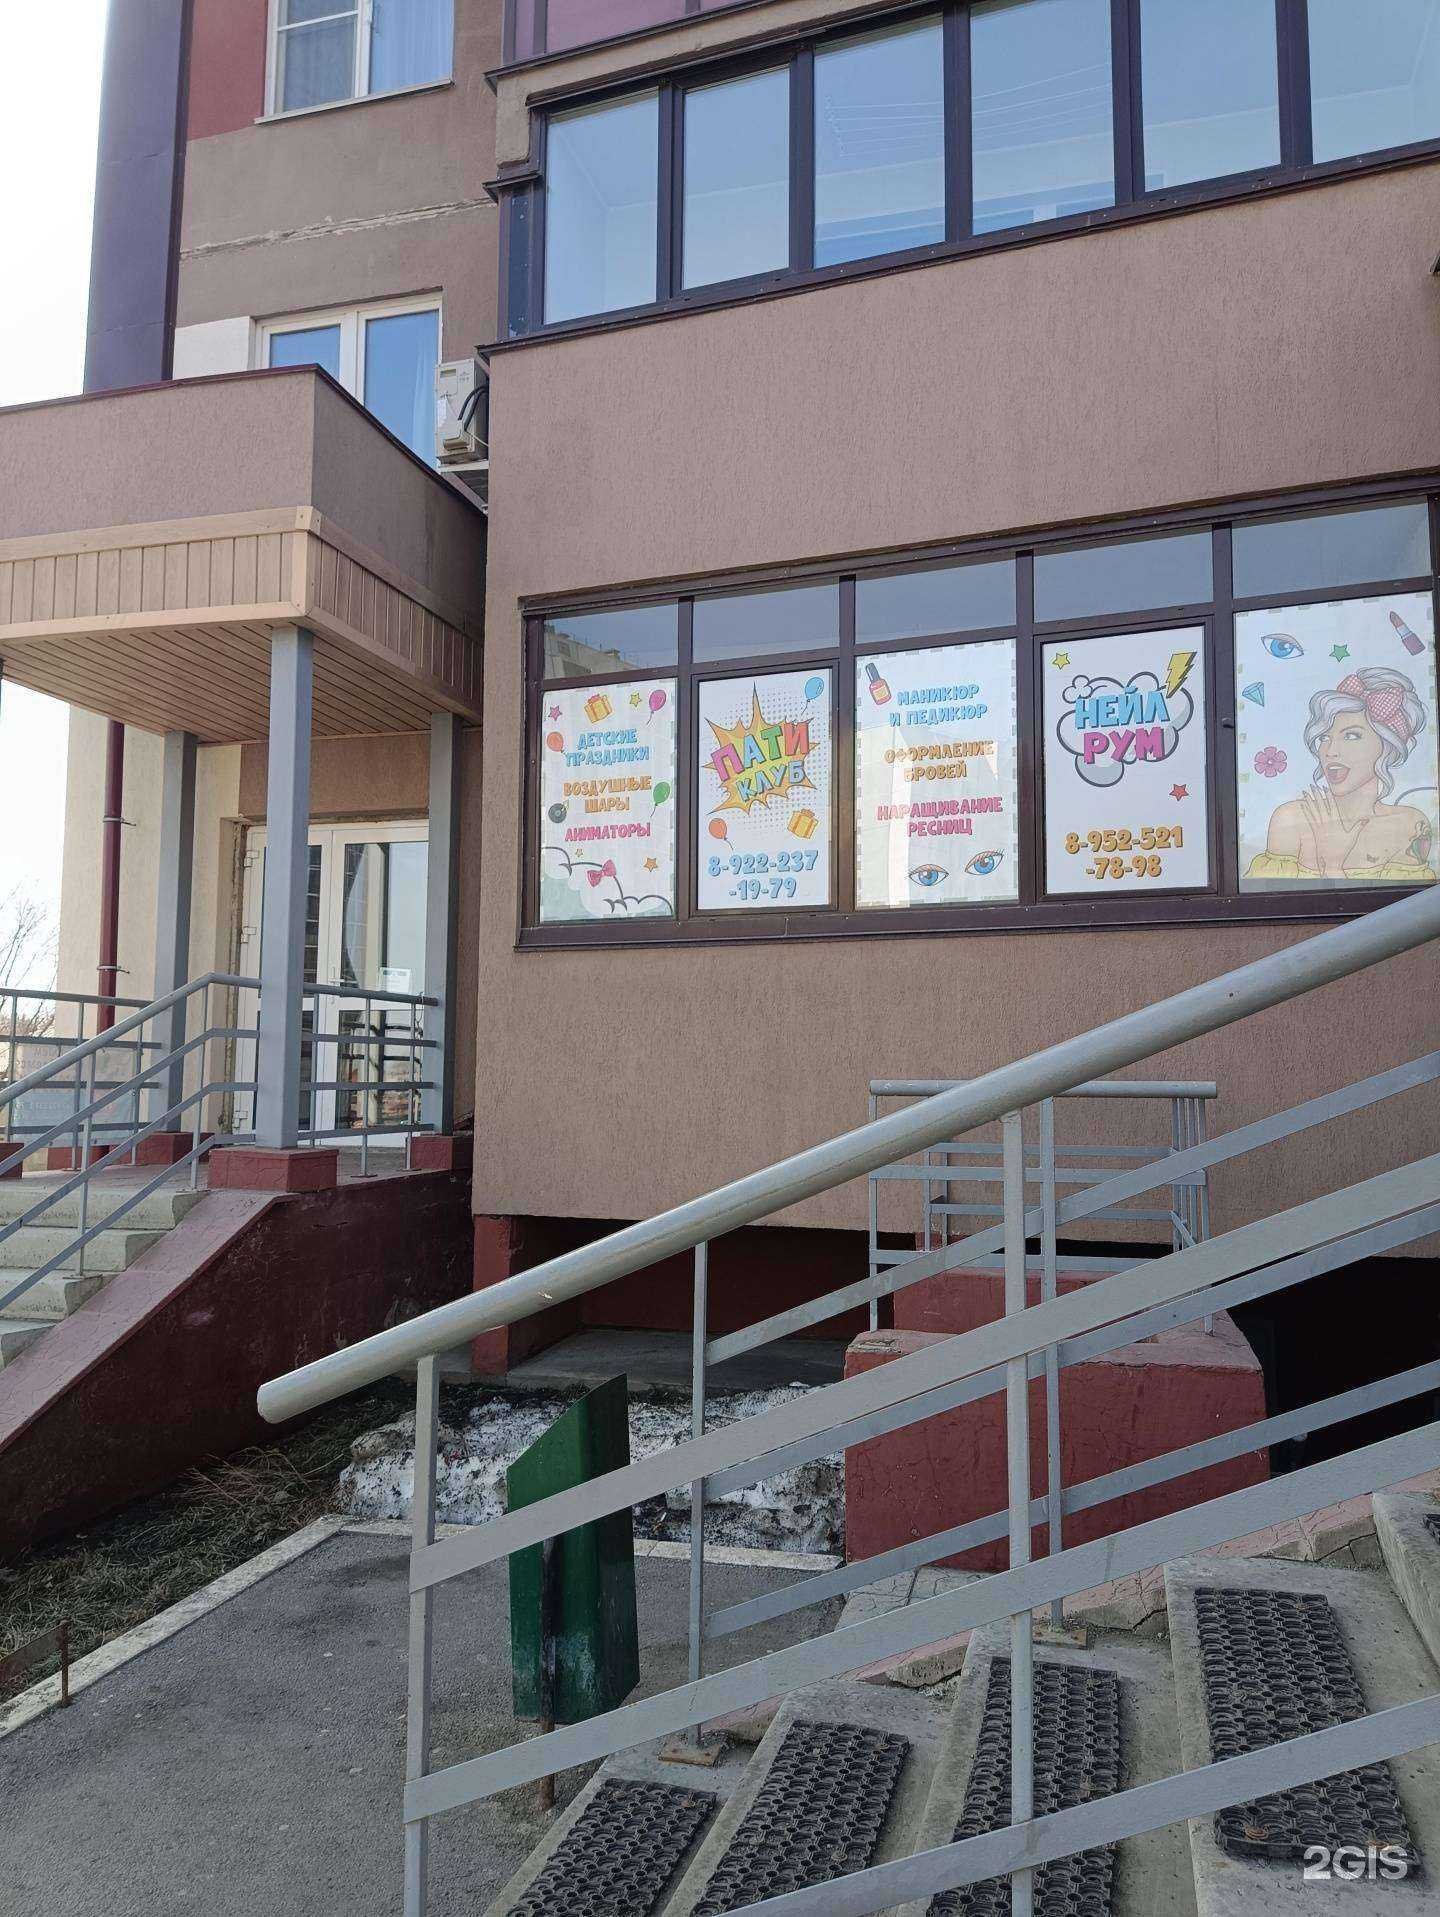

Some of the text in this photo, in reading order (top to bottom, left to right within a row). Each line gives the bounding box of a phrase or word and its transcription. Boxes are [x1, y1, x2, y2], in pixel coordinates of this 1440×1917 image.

[897, 684, 980, 705] МАНИКЮР
[889, 703, 988, 727] И ПЕДИКЮР
[1075, 686, 1170, 729] НЕЙЛ
[577, 729, 638, 750] ДЕТСКИЕ
[711, 722, 810, 781] ПАТИ
[1083, 726, 1165, 764] РУМ
[565, 746, 649, 767] ПРАЗДНИКИ
[563, 776, 652, 796] ВОЗДУШНЫЕ
[736, 761, 805, 801] КЛУБ
[585, 796, 629, 813] ШАРЫ
[877, 797, 1003, 821] НАРАЩИВАНИЕ
[564, 822, 650, 842] АНИМАТОРЫ
[907, 818, 973, 837] РЕСНИЦ
[1065, 825, 1184, 854] 8-952-521
[708, 850, 818, 876] 8-922-237
[1086, 855, 1162, 880] -78-98
[729, 877, 797, 900] -19-79
